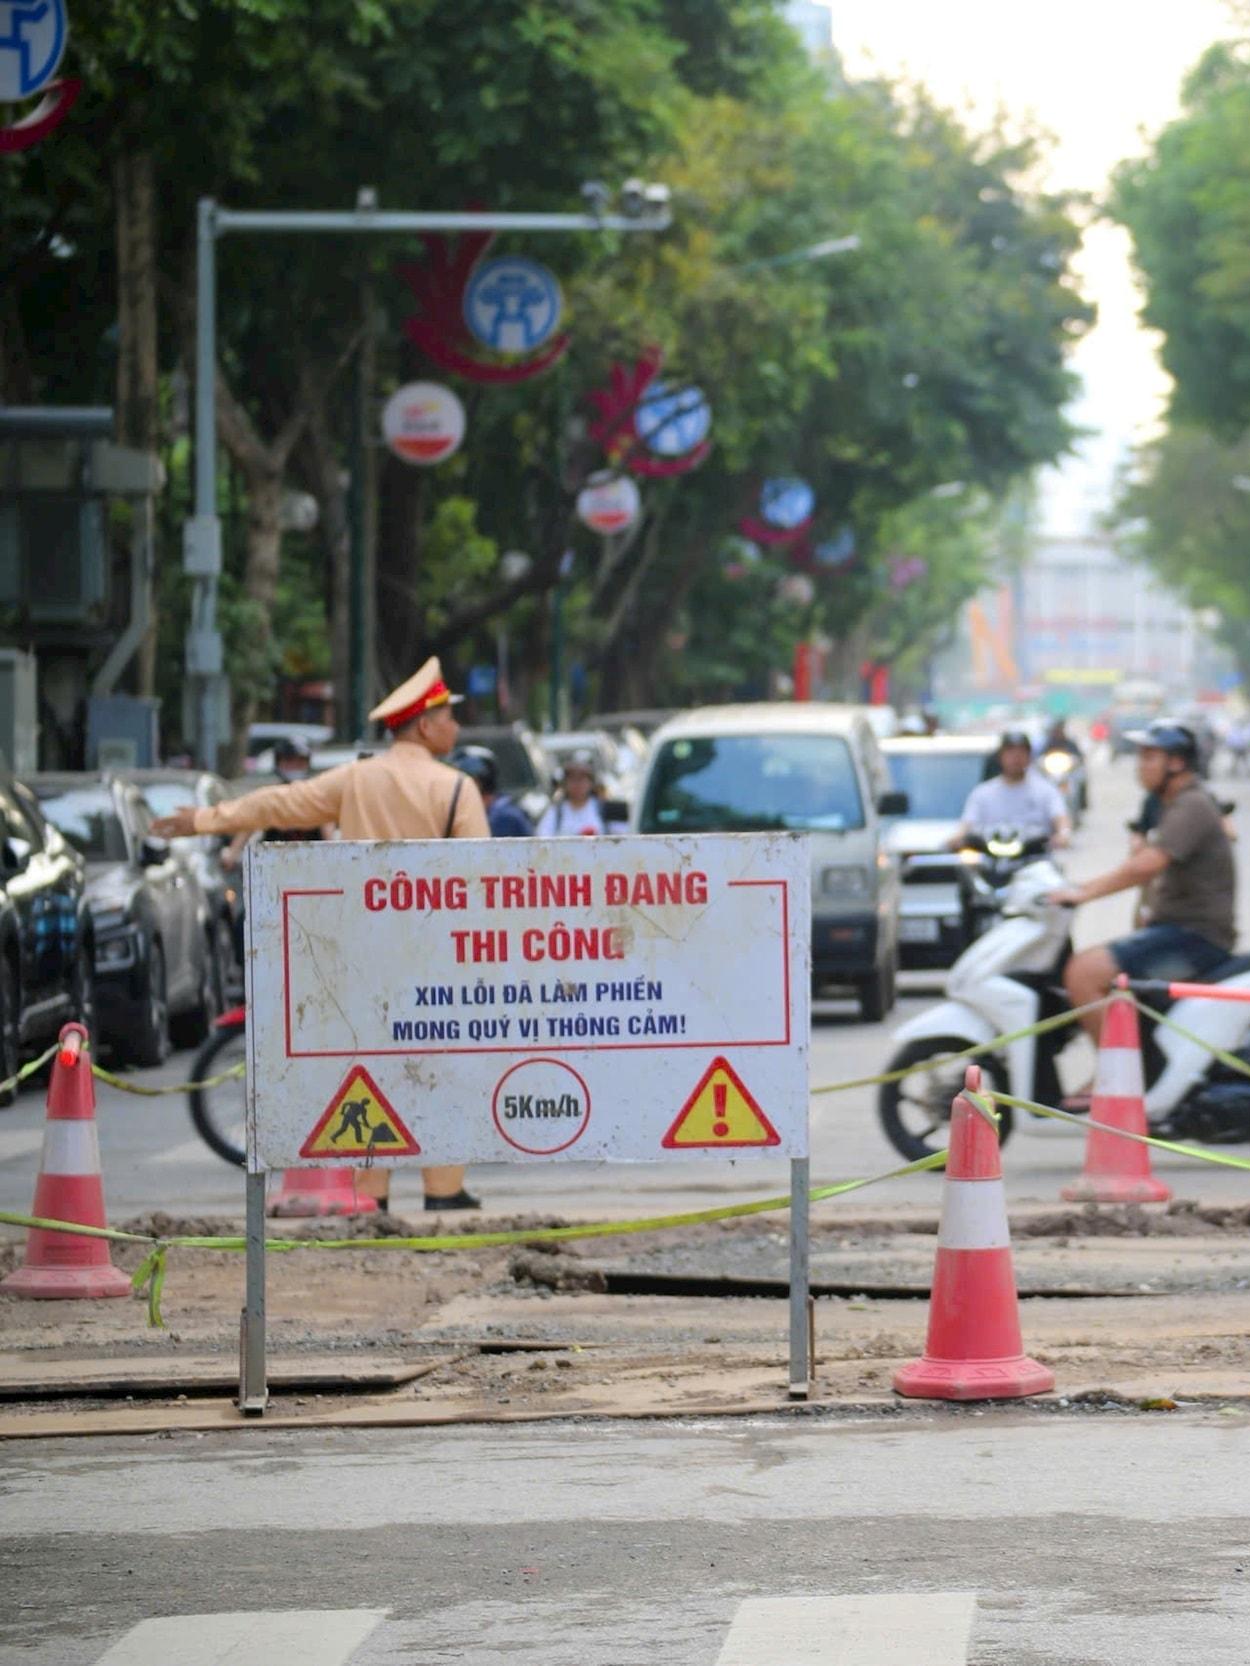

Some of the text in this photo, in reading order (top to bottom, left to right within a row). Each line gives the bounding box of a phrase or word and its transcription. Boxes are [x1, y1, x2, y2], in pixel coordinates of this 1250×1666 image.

[363, 868, 709, 912] CÔNG TRÌNH ĐANG
[450, 921, 625, 963] THI CÔNG
[415, 985, 454, 1006] XIN
[461, 977, 496, 1006] LỖI
[502, 979, 533, 1005] ĐÃ
[540, 978, 588, 1004] LÀM
[392, 1008, 687, 1042] MONG QUÝ VỊ THÔNG CẢM!
[503, 1093, 580, 1121] 5Km/h
